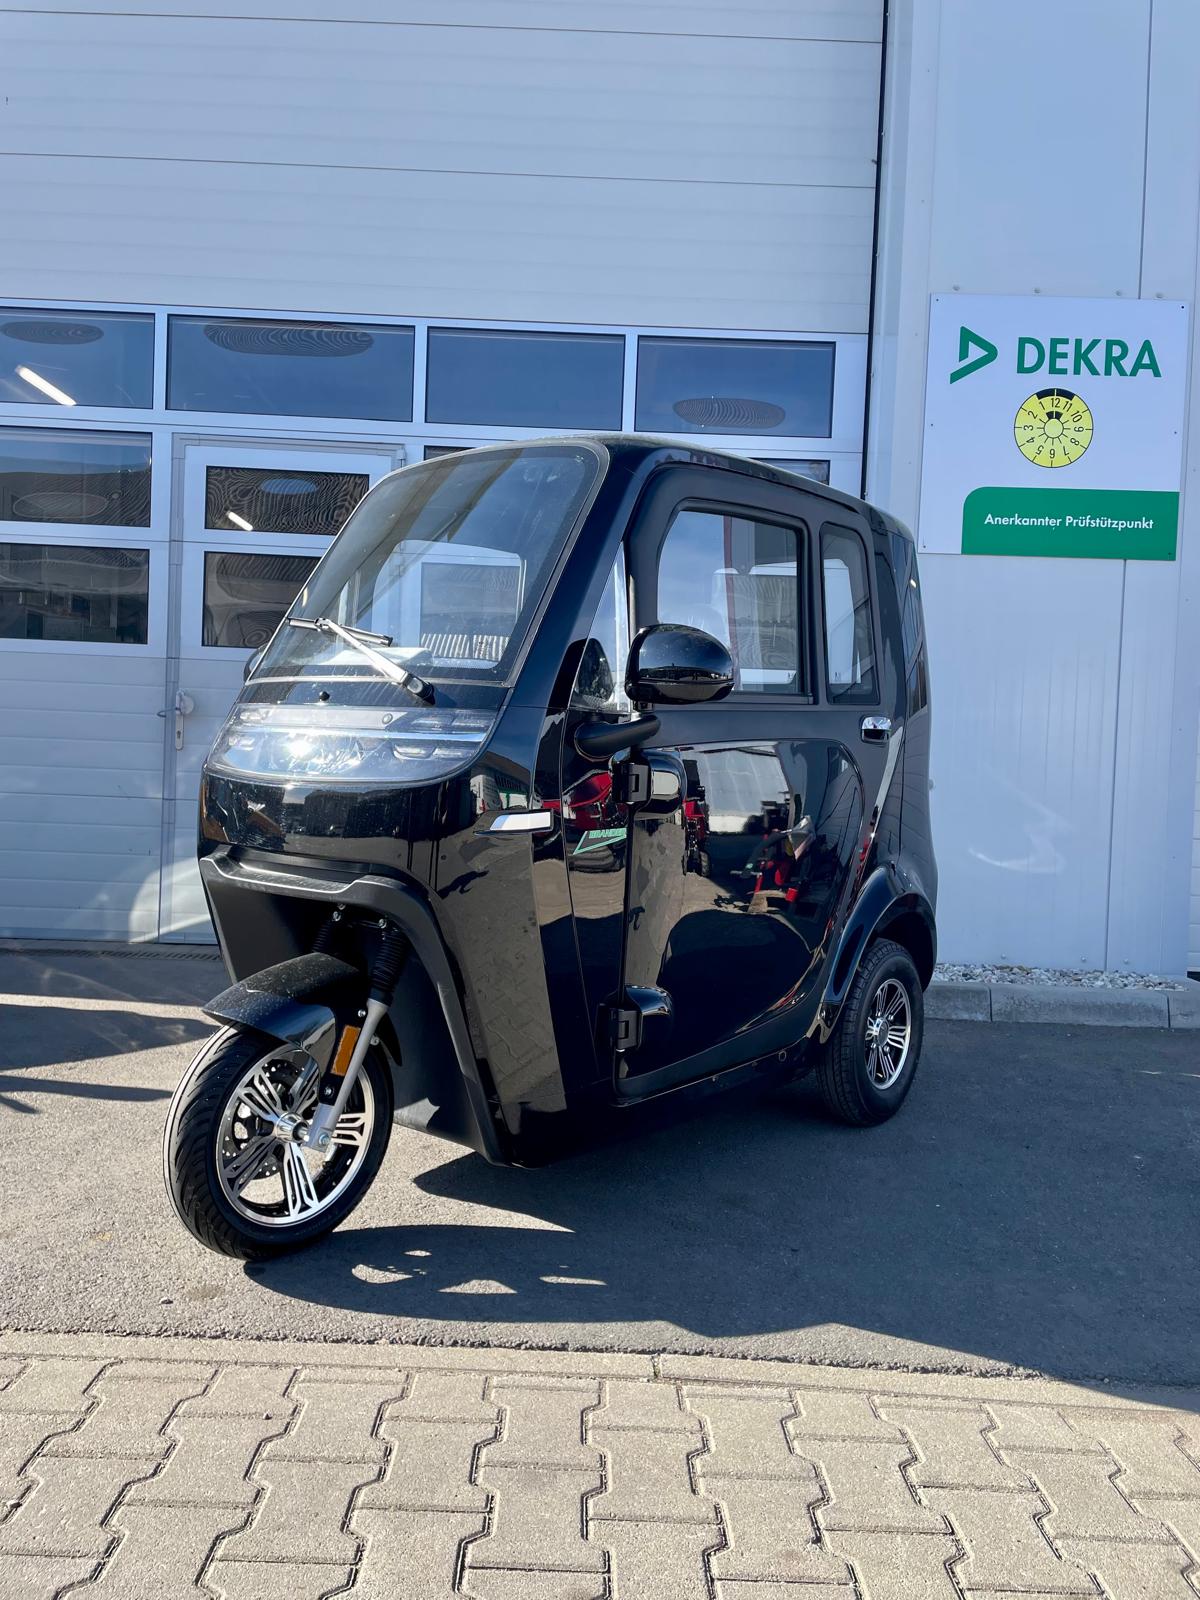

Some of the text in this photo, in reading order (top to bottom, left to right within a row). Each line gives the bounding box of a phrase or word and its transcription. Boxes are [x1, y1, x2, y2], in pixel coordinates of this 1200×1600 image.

[1016, 336, 1162, 378] DEKRA
[1039, 401, 1045, 411] 1
[1050, 397, 1061, 408] 12
[1062, 400, 1073, 413] 11
[1027, 410, 1038, 419] 2
[1070, 410, 1083, 423] 10
[1026, 436, 1035, 444] 4
[1069, 437, 1080, 446] 8
[1035, 445, 1044, 455] 5
[1049, 448, 1056, 459] 6
[1063, 445, 1070, 456] 7
[984, 513, 1154, 532] Anerkannter Prüfstützpunkt
